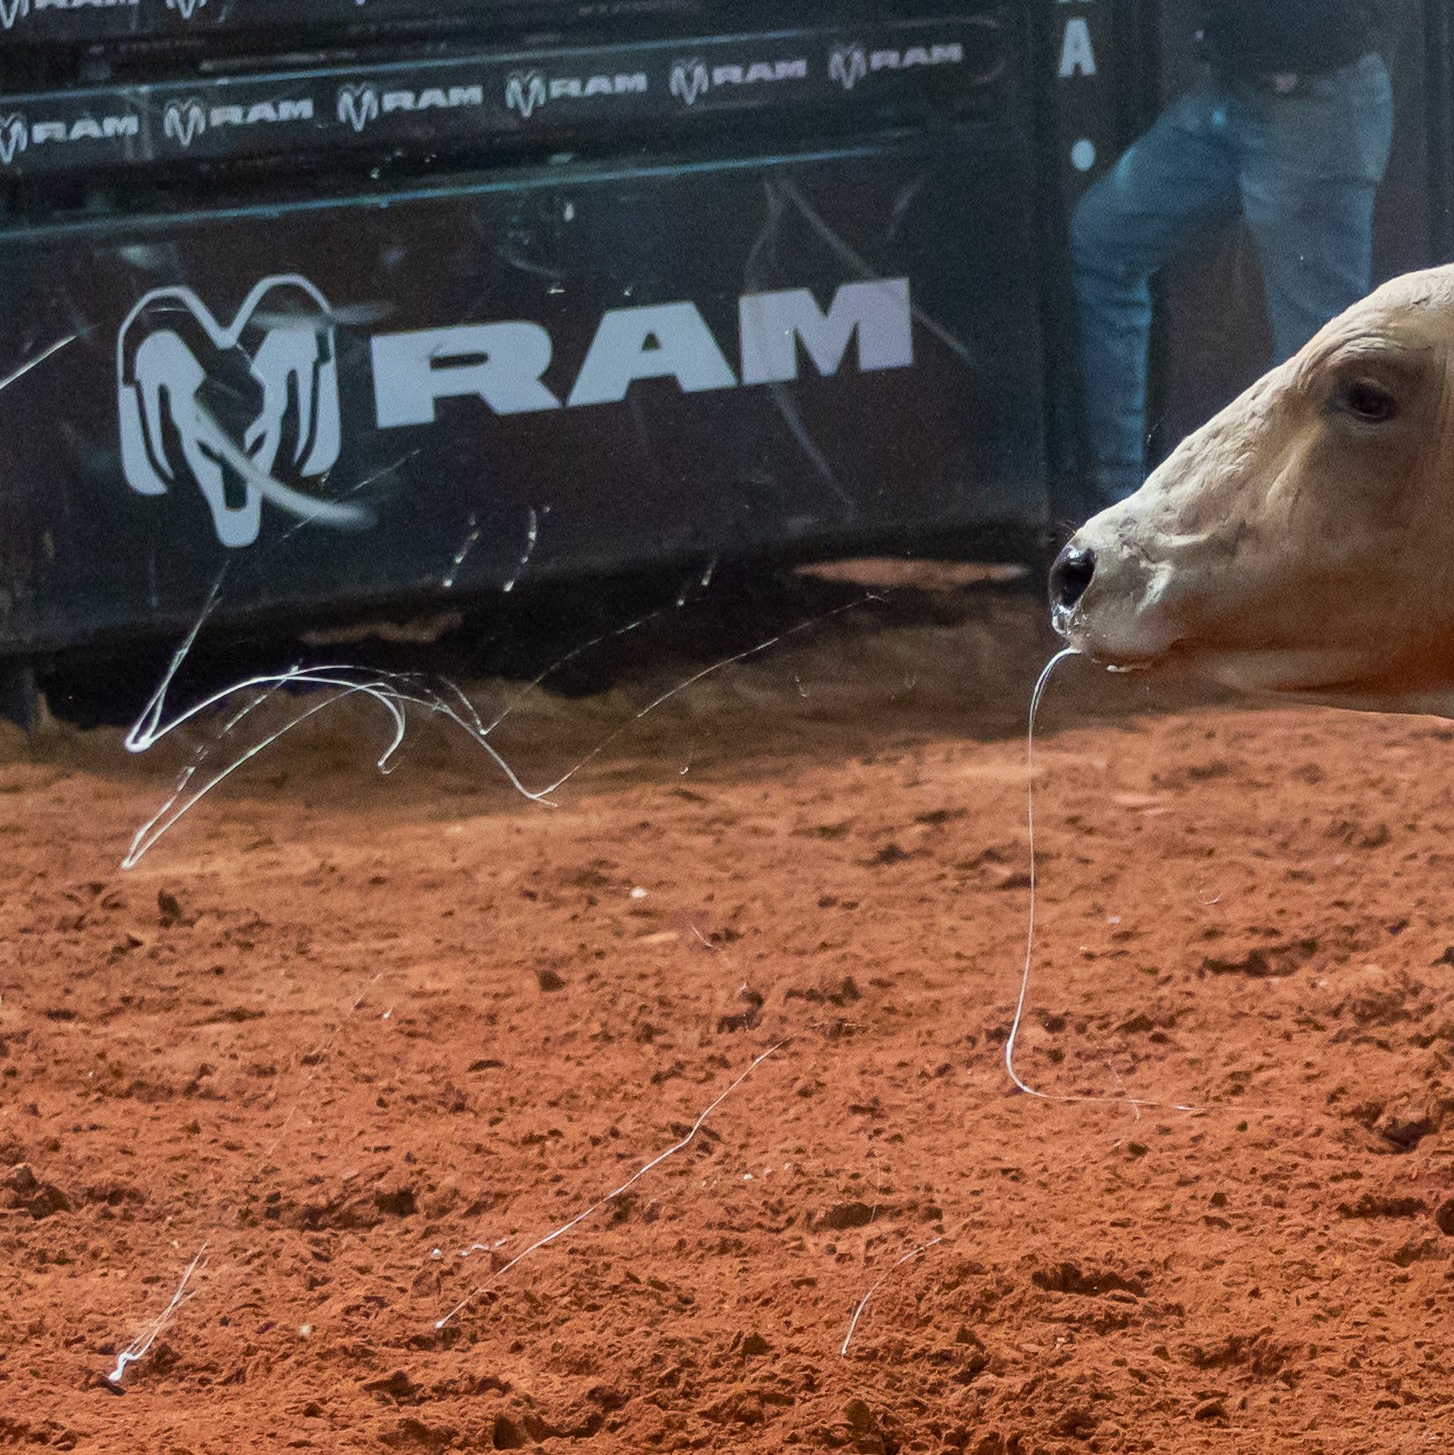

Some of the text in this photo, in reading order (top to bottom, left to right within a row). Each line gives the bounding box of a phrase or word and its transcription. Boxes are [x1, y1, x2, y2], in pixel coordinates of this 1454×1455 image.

[32, 45, 963, 143] RAM RAM RAM RAM RAM RAM
[370, 278, 914, 428] RAM
